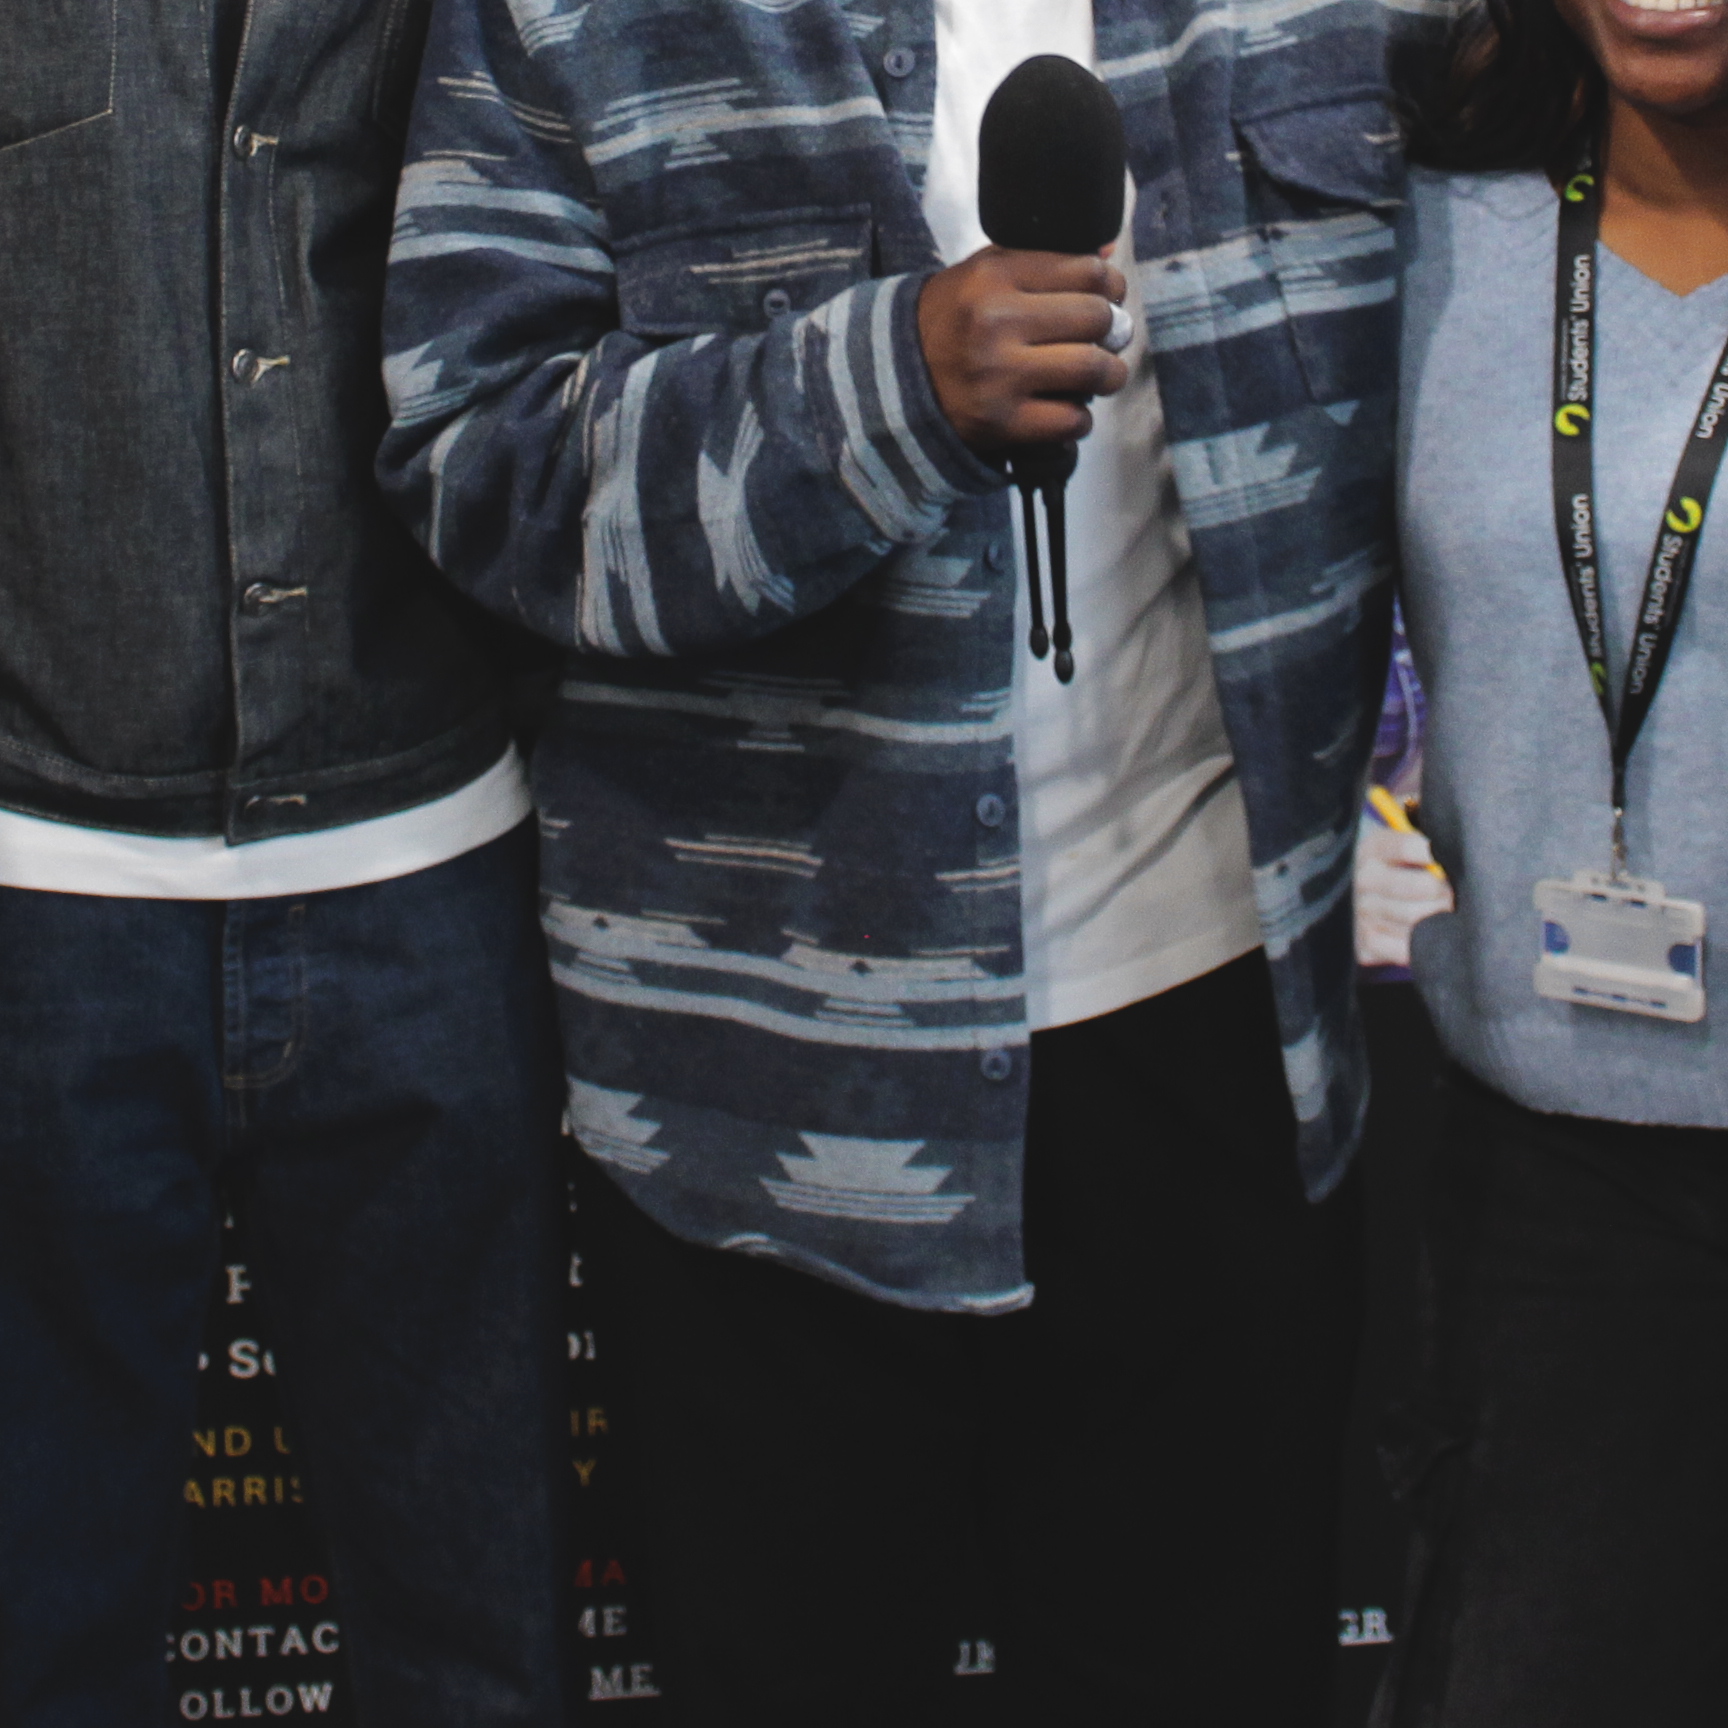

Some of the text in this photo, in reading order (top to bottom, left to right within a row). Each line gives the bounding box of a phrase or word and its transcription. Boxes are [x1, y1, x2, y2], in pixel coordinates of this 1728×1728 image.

[1570, 253, 1591, 313] Union
[1571, 492, 1593, 559] Union
[1629, 631, 1658, 695] Union
[166, 1619, 341, 1665] ONTAC
